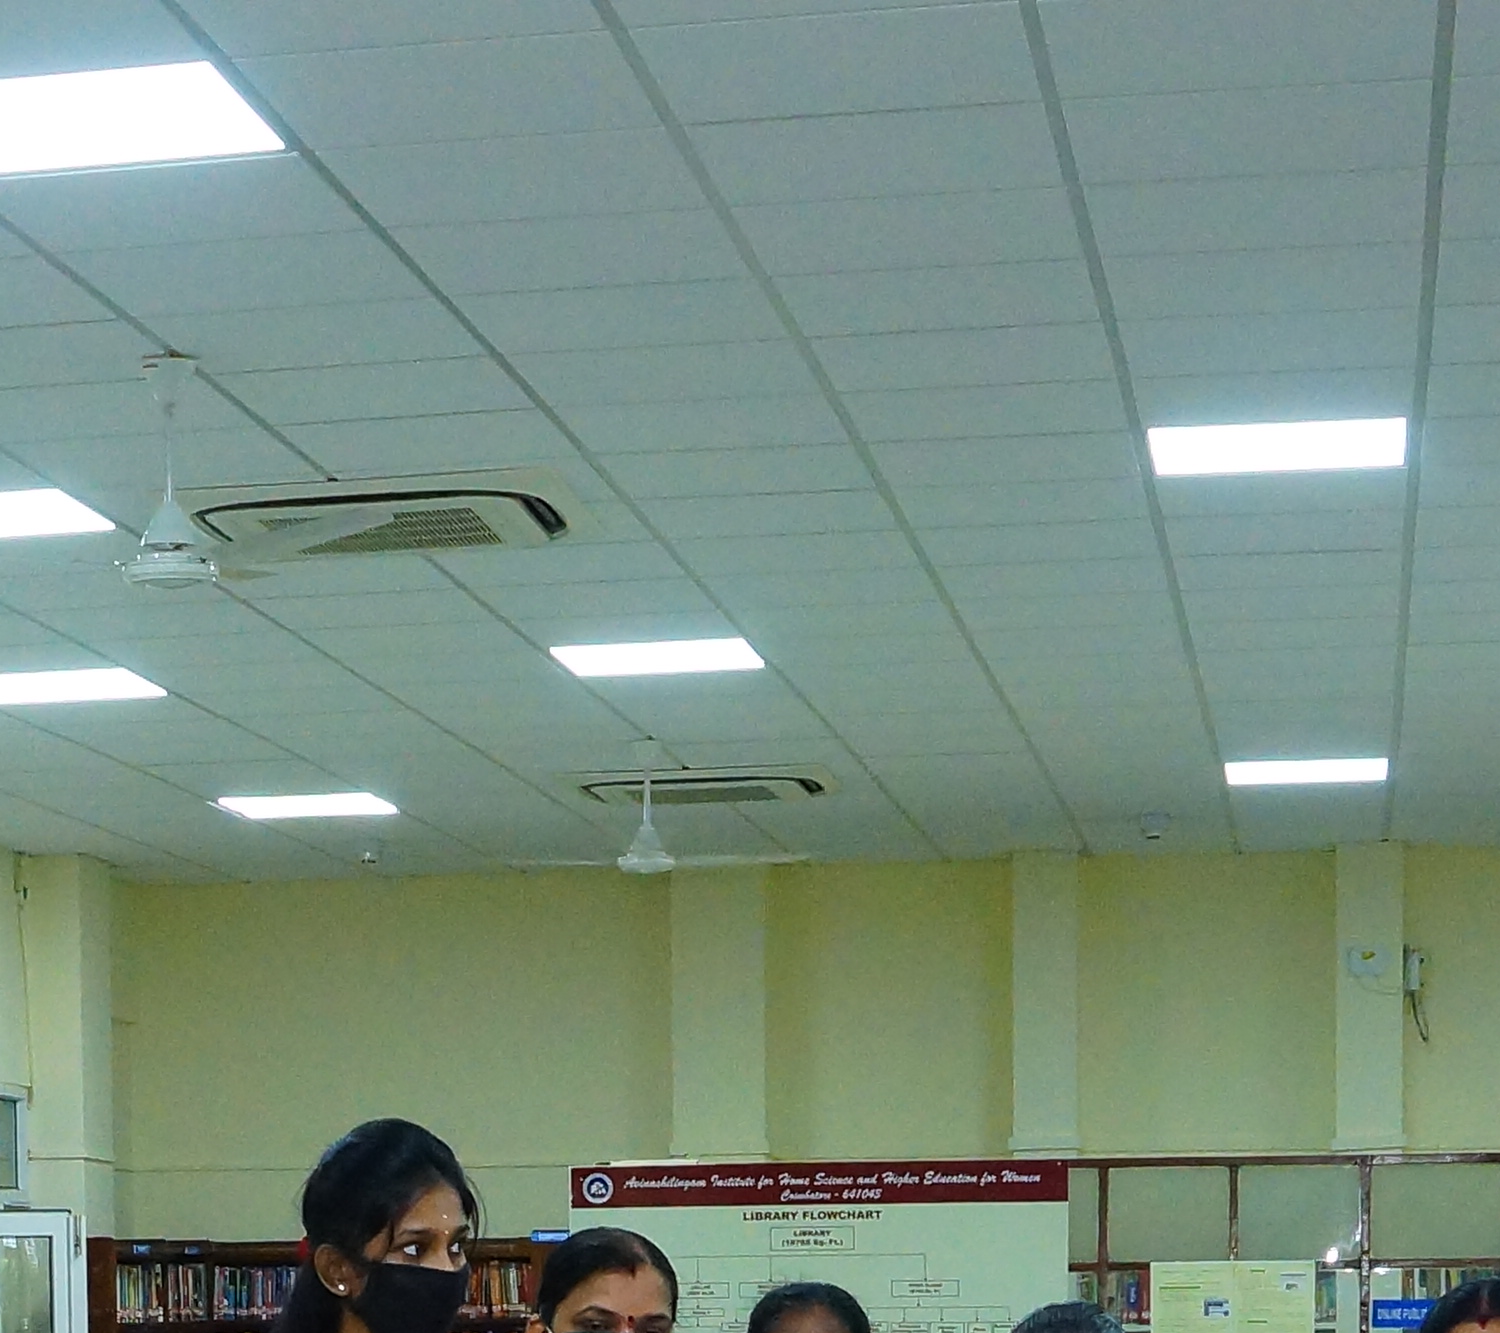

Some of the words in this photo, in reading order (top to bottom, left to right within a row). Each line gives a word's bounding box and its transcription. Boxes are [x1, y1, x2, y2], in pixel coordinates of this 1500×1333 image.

[711, 1173, 754, 1188] Institute
[755, 1175, 774, 1190] for
[777, 1172, 810, 1187] Home
[813, 1172, 853, 1187] Science
[856, 1173, 878, 1186] and
[881, 1170, 920, 1188] Higher
[923, 1169, 977, 1186] Education
[979, 1171, 998, 1187] for
[1000, 1169, 1041, 1184] Women
[842, 1188, 883, 1200] 641043
[742, 1210, 799, 1222] LIBRARY
[802, 1209, 883, 1221] FLOWCHART
